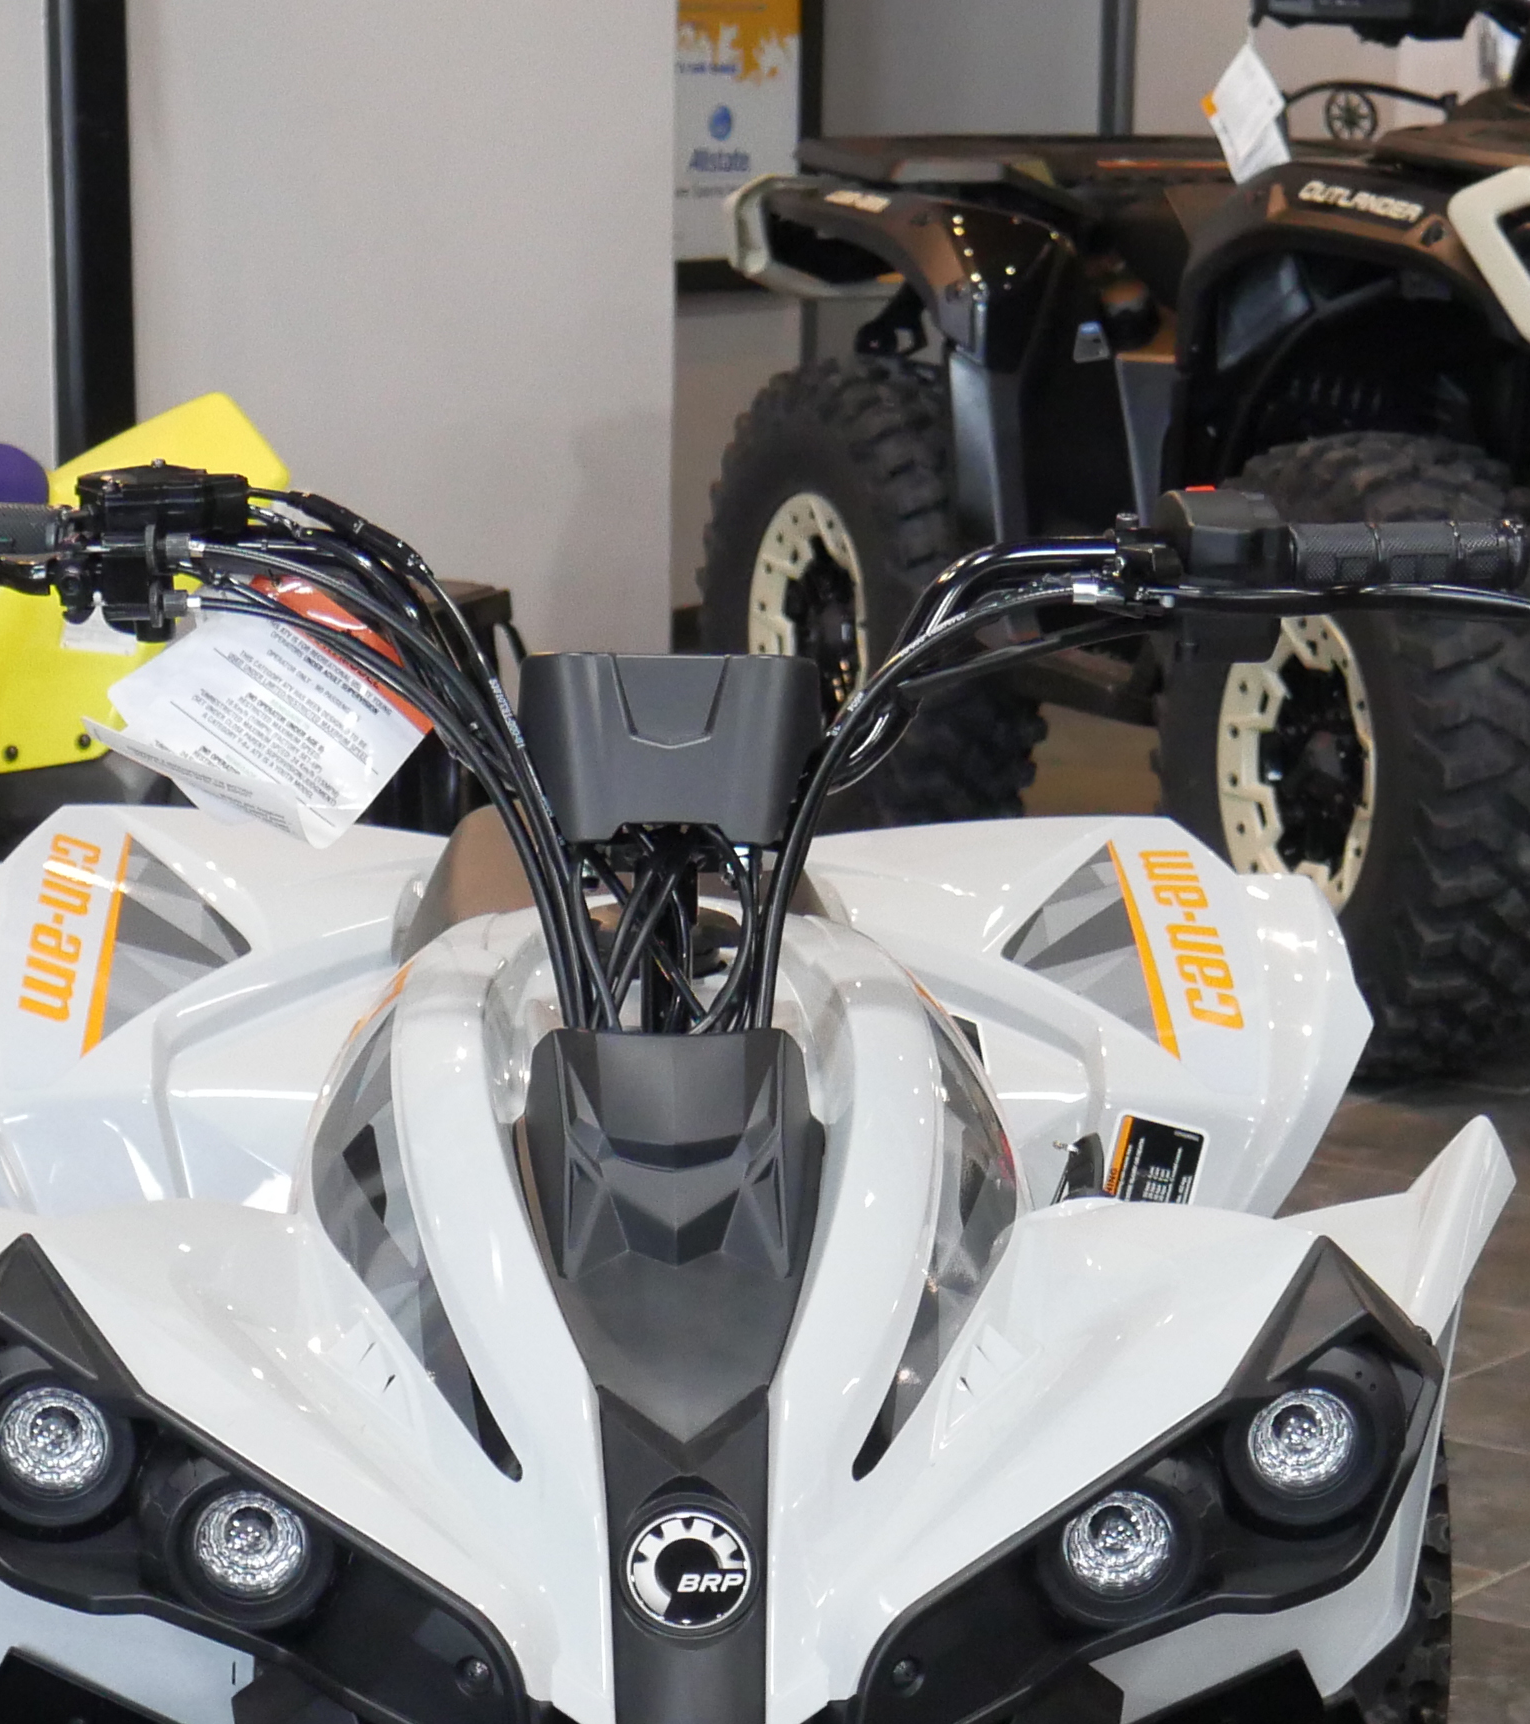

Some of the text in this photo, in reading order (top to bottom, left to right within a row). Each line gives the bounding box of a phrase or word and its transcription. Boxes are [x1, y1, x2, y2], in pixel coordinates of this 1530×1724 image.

[1298, 179, 1423, 223] OUTLANDER
[241, 662, 264, 682] UNDER
[265, 647, 297, 674] OPERATOR
[294, 669, 311, 684] ONLY
[269, 629, 380, 715] OPERATORS UNDER ADULT SUPERVISION
[308, 647, 351, 683] RECREATIONAL
[252, 659, 282, 685] CATEGORY
[304, 697, 322, 713] BEEN
[320, 709, 351, 736] DESIGND
[256, 698, 287, 724] OPERATOR
[285, 720, 306, 739] UNDER
[204, 702, 226, 722] UNDER
[242, 730, 266, 751] PARENT
[241, 719, 271, 745] MAXIMUM
[270, 719, 301, 746] MAXIMUM
[206, 714, 237, 741] CATEGORY
[292, 779, 315, 799] MODEL
[18, 832, 102, 1023] can-am
[1139, 849, 1244, 1030] can-am
[676, 1573, 744, 1593] BRP
